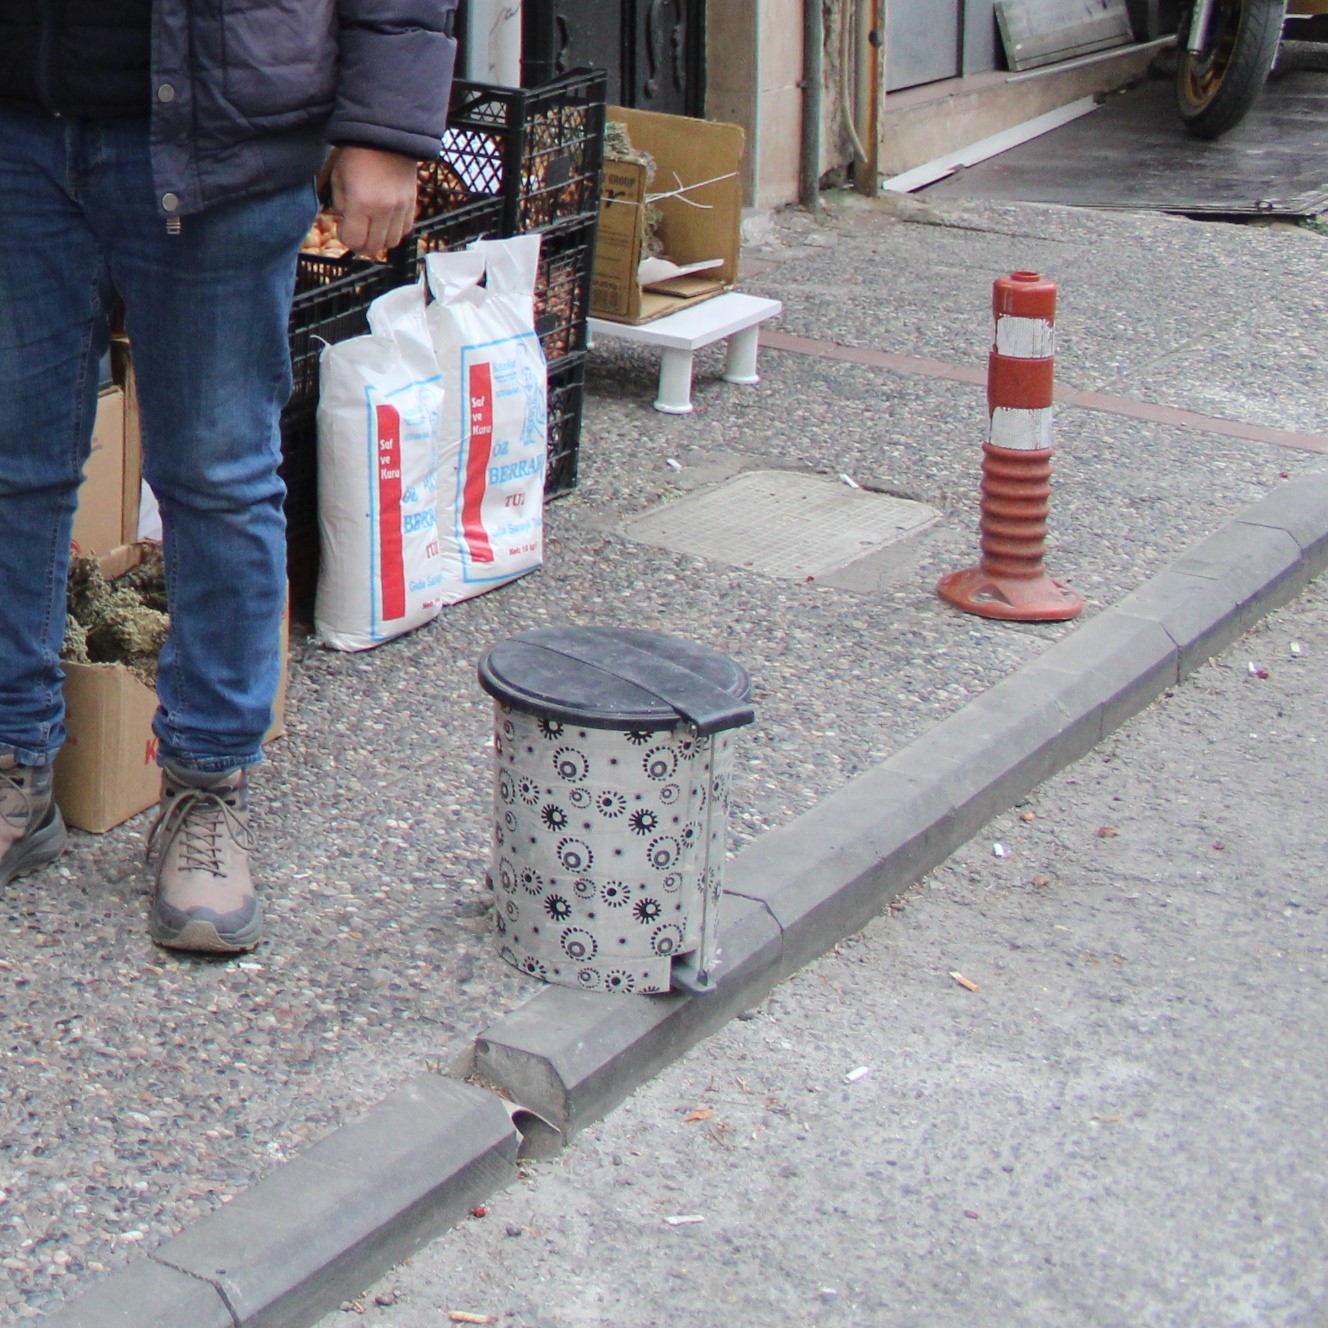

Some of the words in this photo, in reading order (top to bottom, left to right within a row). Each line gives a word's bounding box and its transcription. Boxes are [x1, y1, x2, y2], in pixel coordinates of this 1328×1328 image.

[472, 413, 483, 422] ve
[380, 438, 393, 450] Saf
[380, 455, 391, 464] ve
[380, 468, 400, 480] Kuru
